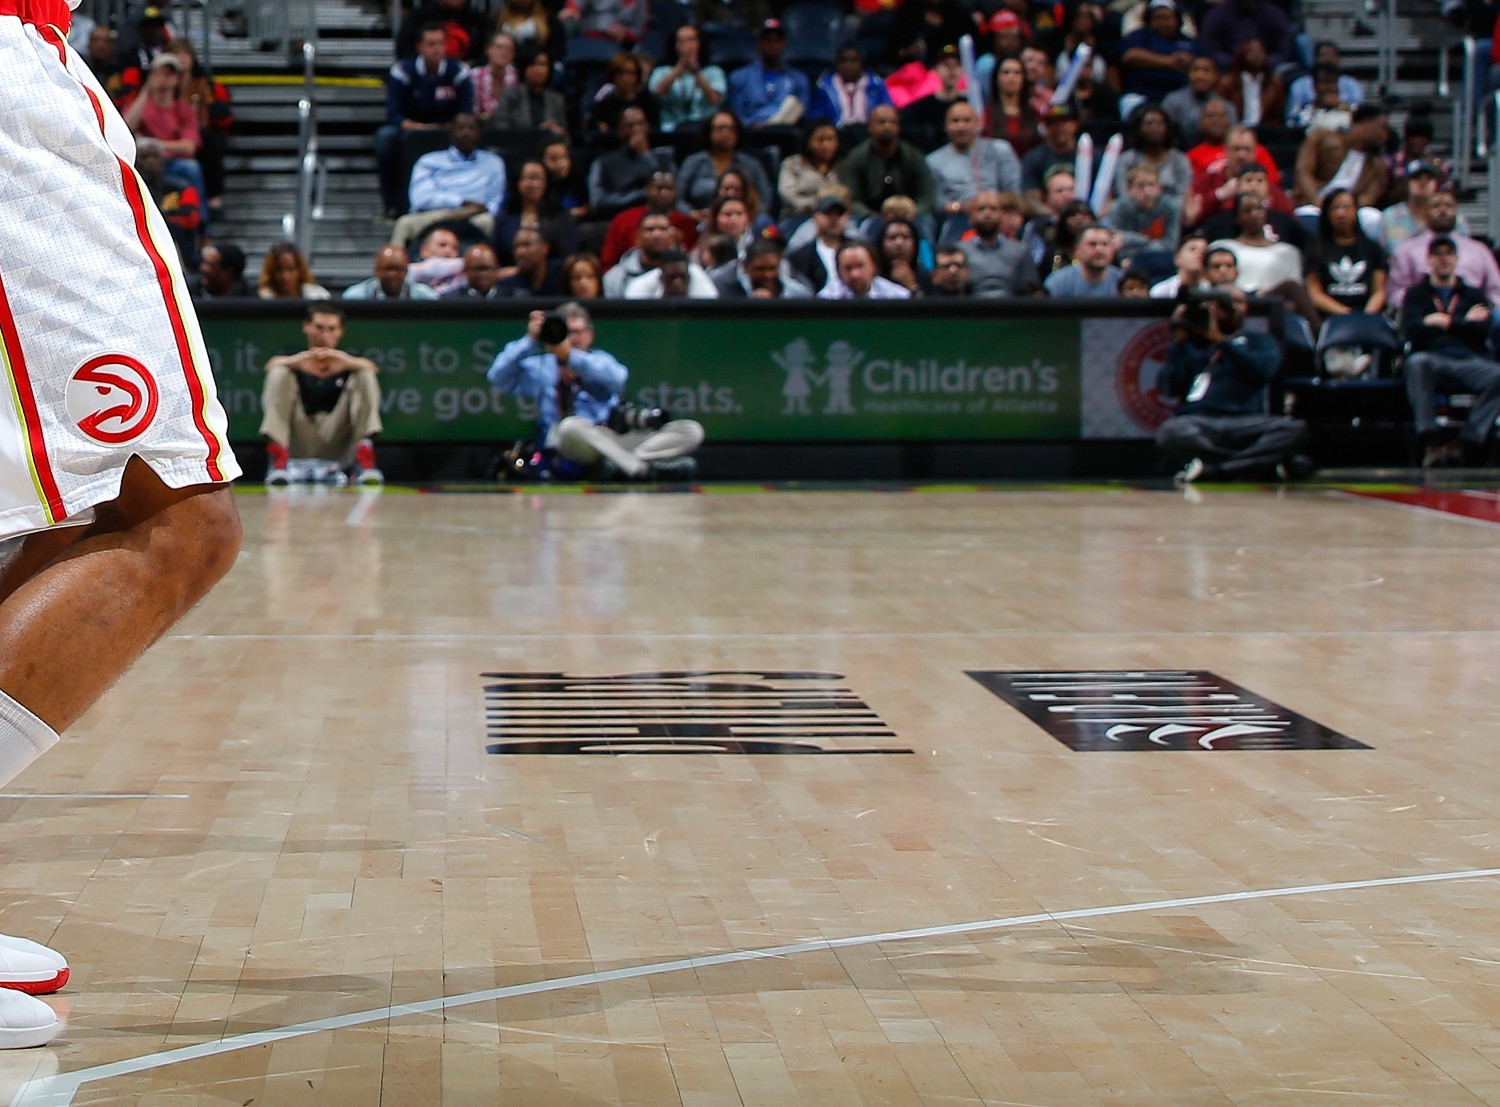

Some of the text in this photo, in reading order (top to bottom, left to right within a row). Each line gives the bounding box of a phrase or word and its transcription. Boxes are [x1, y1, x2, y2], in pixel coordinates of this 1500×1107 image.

[419, 341, 460, 374] to
[863, 359, 1059, 393] Children's
[433, 385, 503, 421] got
[637, 381, 744, 414] stats.
[479, 671, 916, 754] PHILIPS
[996, 671, 1292, 726] ARENA
